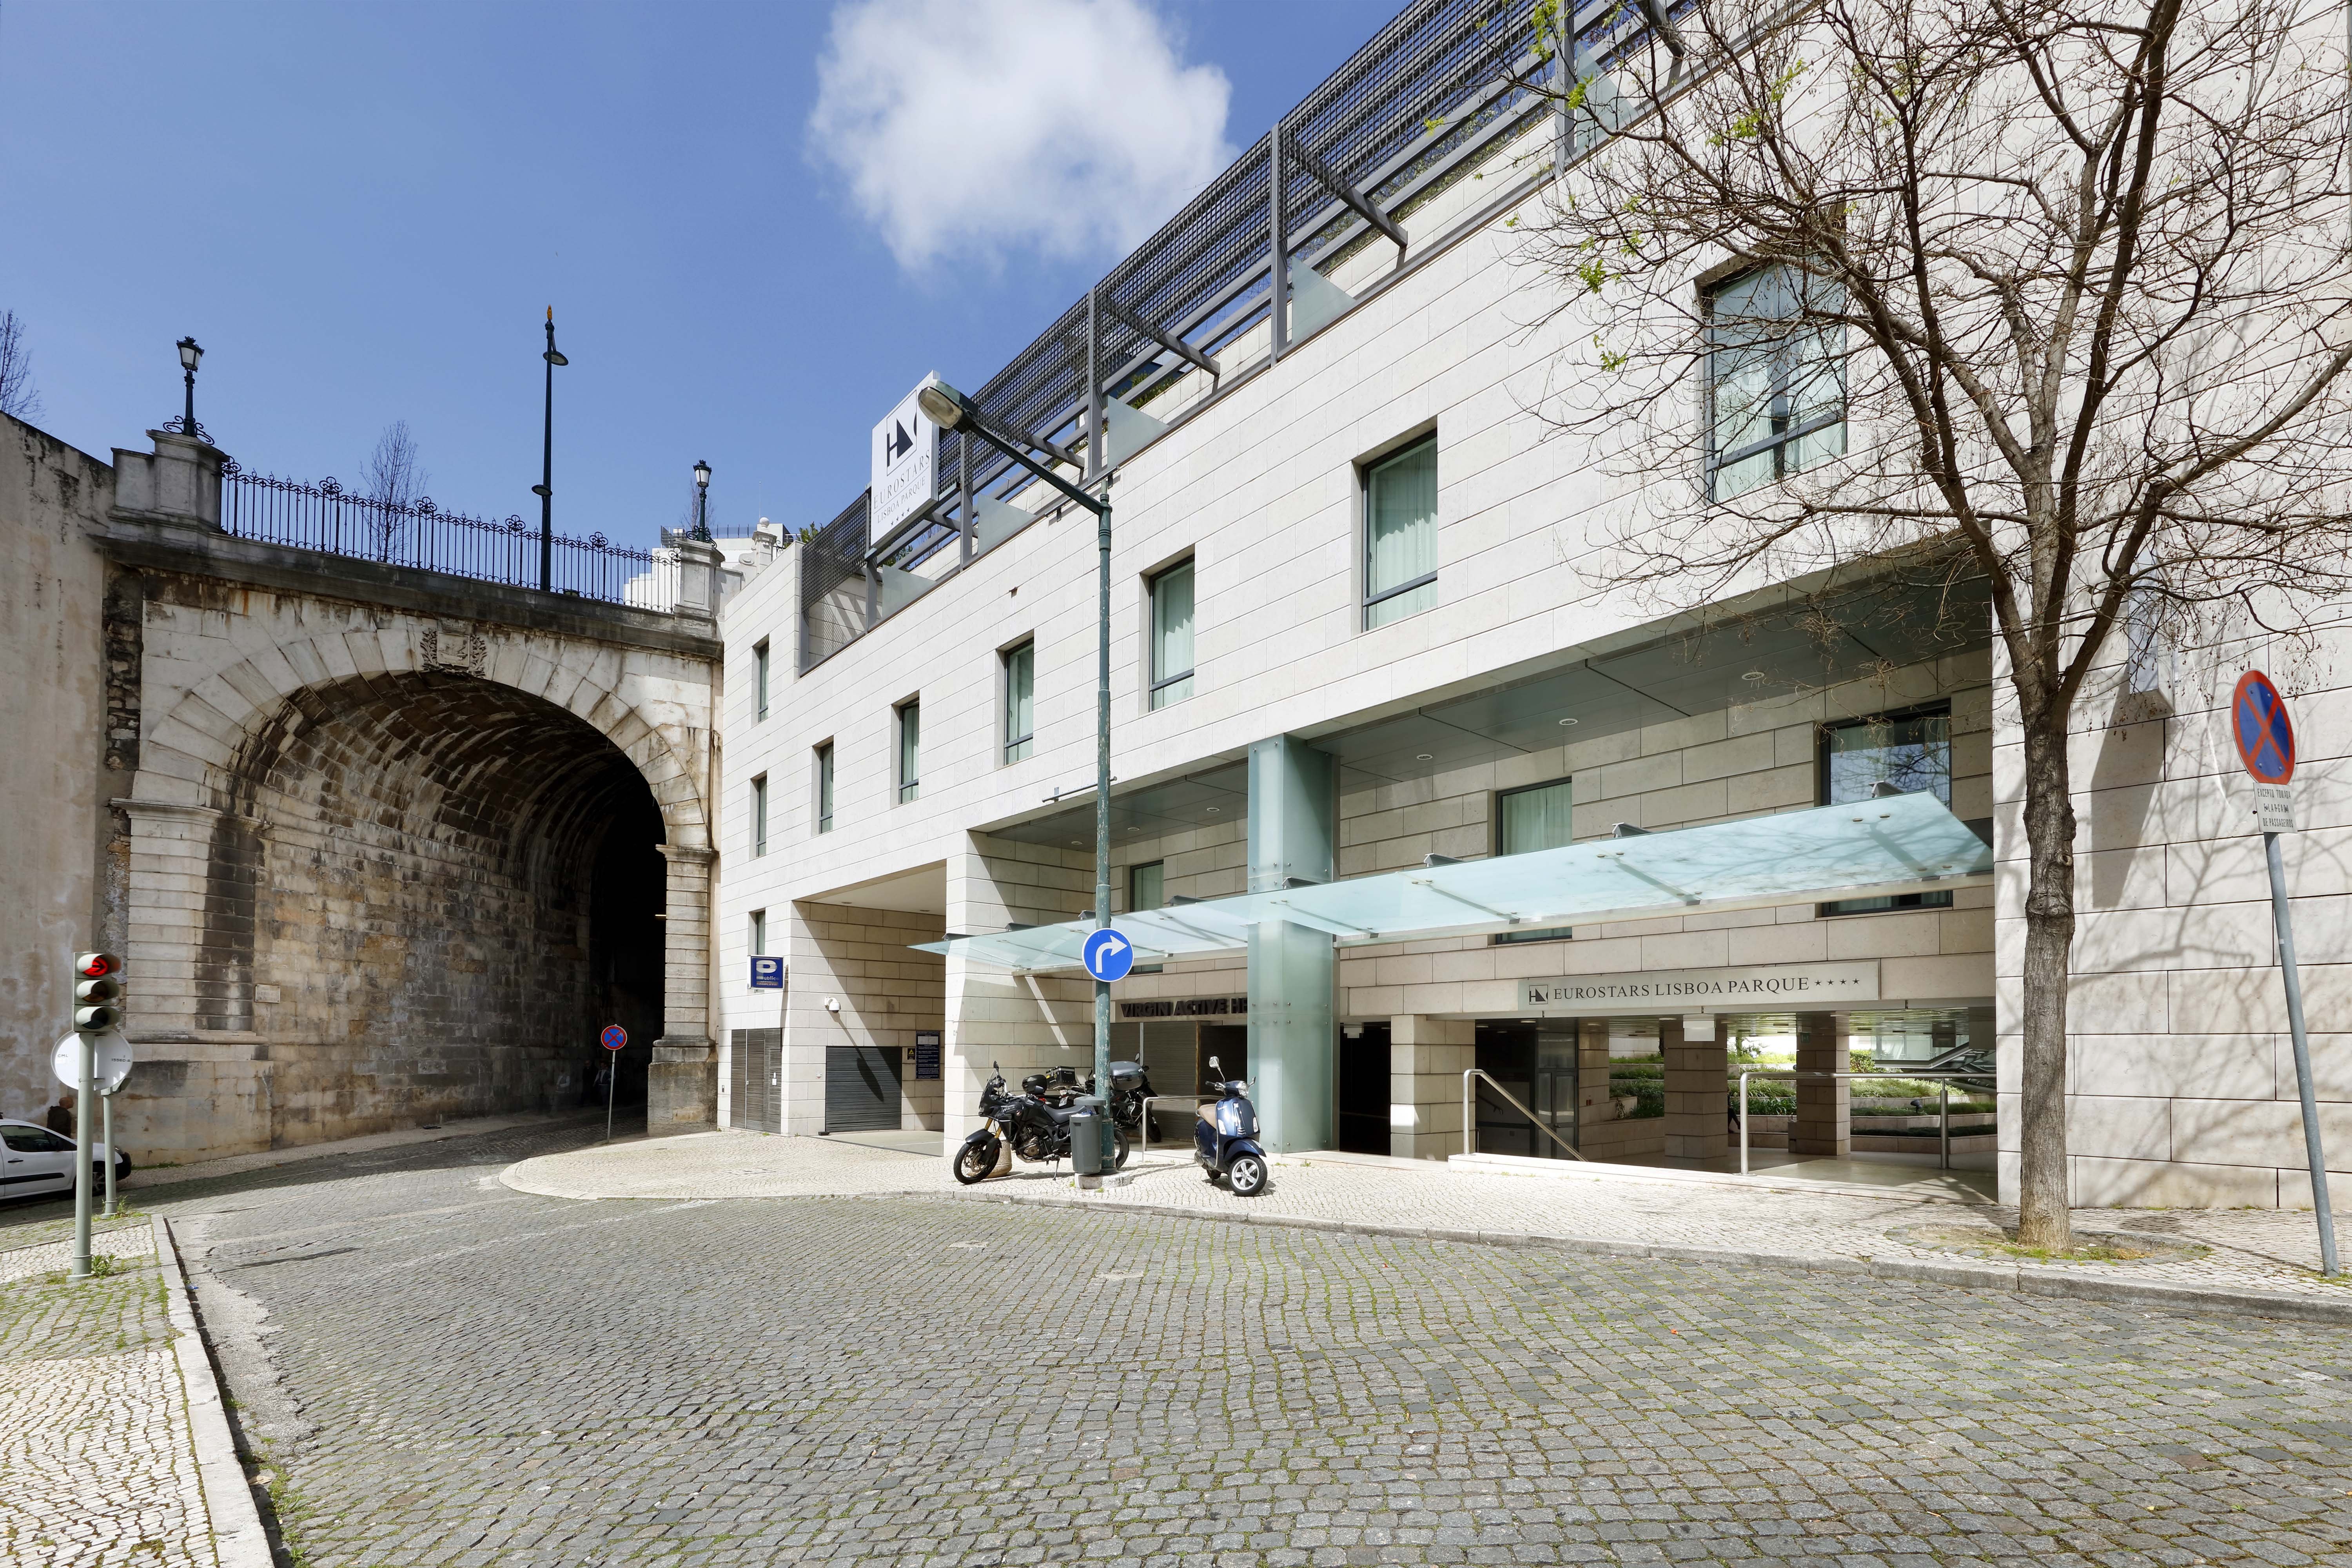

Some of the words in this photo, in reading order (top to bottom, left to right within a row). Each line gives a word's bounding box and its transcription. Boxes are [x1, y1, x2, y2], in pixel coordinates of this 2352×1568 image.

[874, 449, 929, 509] EUROSTARS
[878, 500, 899, 524] LISBOA
[901, 475, 925, 505] PARQUE
[2258, 788, 2274, 798] EXCEPTO
[2276, 789, 2291, 799] TOMADA
[2263, 818, 2268, 826] DE
[2269, 818, 2293, 828] PASSAGEIROS
[1554, 984, 1649, 1000] EUROSTARS
[1655, 982, 1723, 996] LISBOA
[1726, 978, 1809, 994] PARQUE
[1120, 1002, 1173, 1017] VIRGIN
[1173, 999, 1228, 1016] ACTIVE
